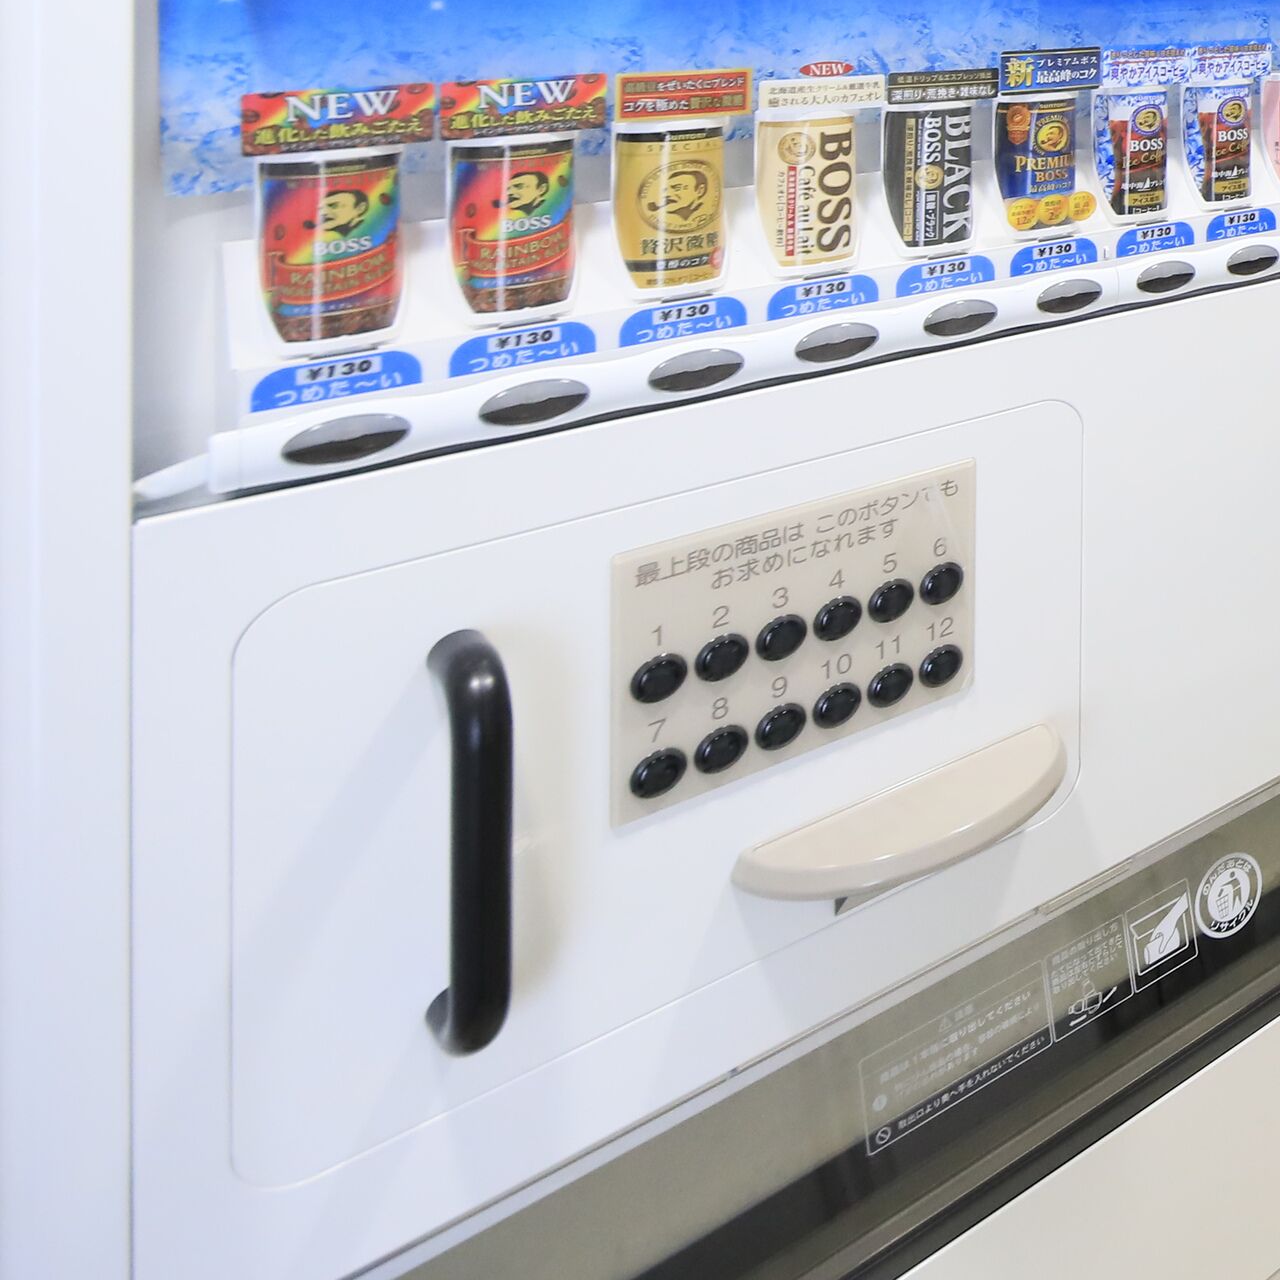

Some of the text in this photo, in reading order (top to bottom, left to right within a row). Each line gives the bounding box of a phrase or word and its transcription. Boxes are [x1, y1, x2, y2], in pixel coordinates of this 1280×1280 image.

[808, 63, 847, 76] NEW
[1005, 56, 1035, 88] 新
[1035, 55, 1098, 68] プレミアムボス
[1035, 68, 1098, 84] 最高峰のコク
[476, 79, 577, 110] NEW
[285, 89, 400, 123] NEW
[450, 105, 598, 131] 進化した飲みごたえ
[254, 116, 424, 145] 進化した飲みごたえ
[1217, 127, 1249, 142] BOSS
[1129, 138, 1164, 152] BOSS
[942, 114, 972, 240] BLACK
[1035, 170, 1068, 184] BOSS
[816, 127, 853, 254] BOSS
[501, 214, 552, 234] BOSS
[1227, 212, 1257, 227] ¥130
[1141, 226, 1173, 241] ¥130
[314, 235, 373, 257] BOSS
[1037, 244, 1072, 259] ¥130
[926, 260, 966, 277] ¥130
[800, 280, 846, 297] ¥130
[659, 303, 710, 321] ¥130
[496, 329, 555, 349] ¥130
[306, 358, 374, 380] ¥130
[634, 520, 806, 589] 最上段の商品は
[709, 516, 900, 591] お求めになれます
[932, 536, 948, 558] 6
[881, 552, 899, 575] 5
[827, 569, 847, 591] 4
[771, 586, 790, 609] 3
[711, 603, 731, 630] 2
[651, 625, 665, 647] 1
[925, 616, 955, 641] 12
[874, 635, 903, 661] 11
[820, 653, 853, 681] 10
[770, 676, 789, 699] 9
[711, 696, 730, 721] 8
[648, 718, 667, 745] 7
[1209, 898, 1254, 933] リサイクル
